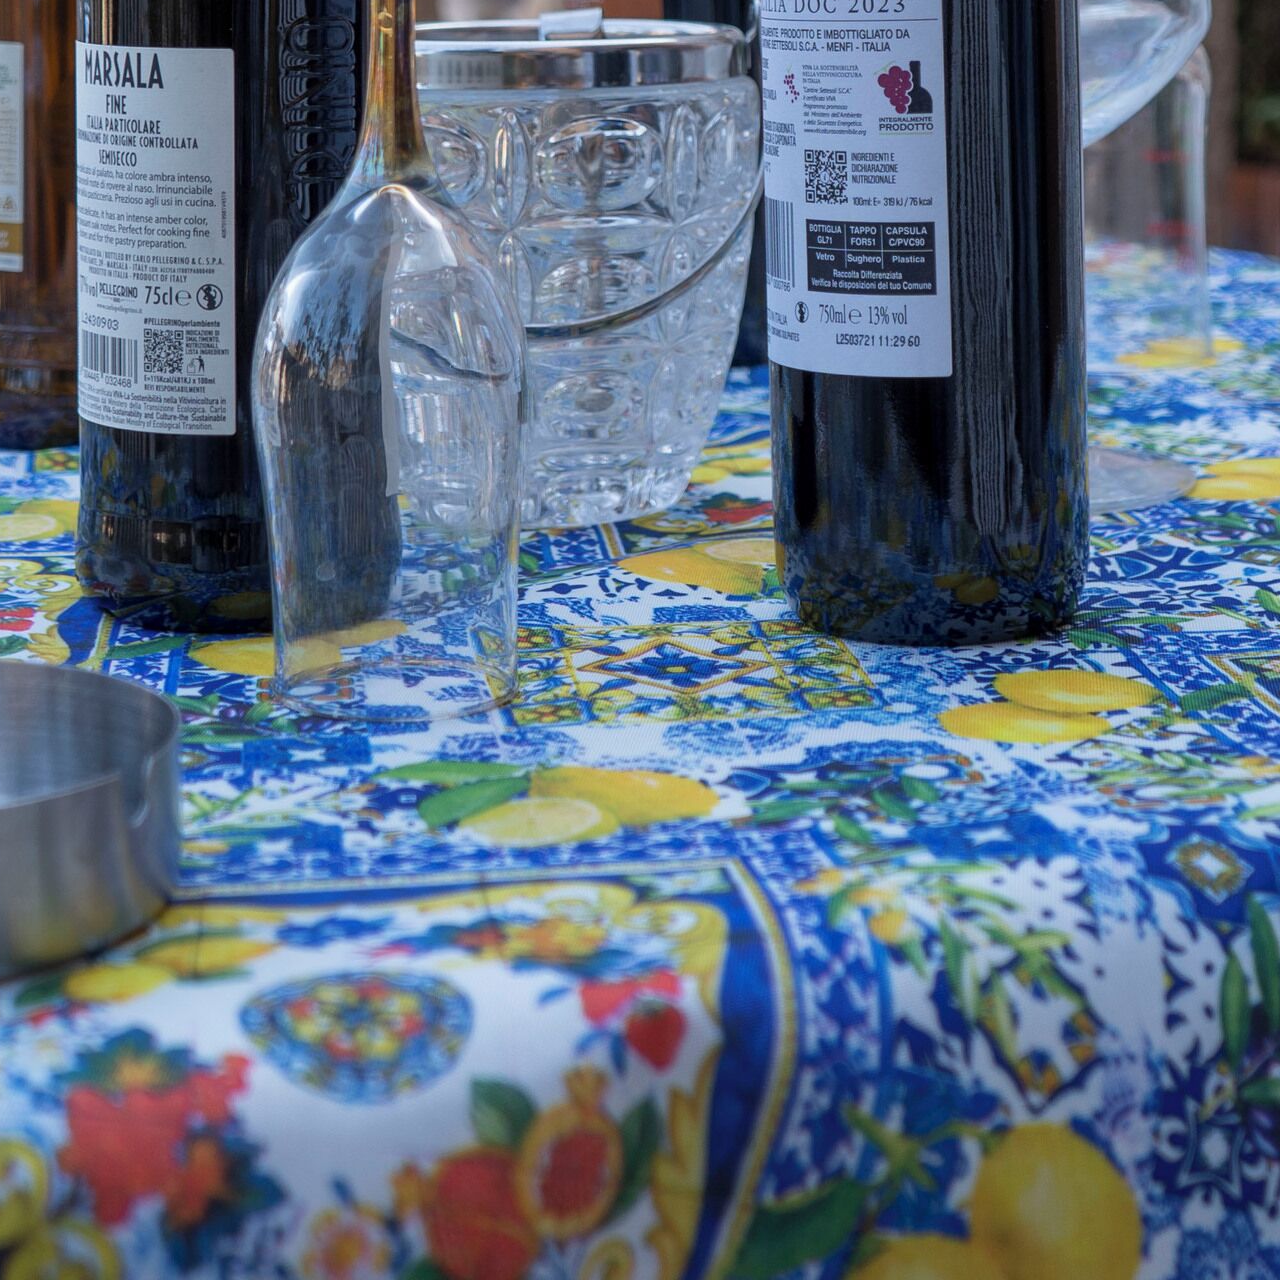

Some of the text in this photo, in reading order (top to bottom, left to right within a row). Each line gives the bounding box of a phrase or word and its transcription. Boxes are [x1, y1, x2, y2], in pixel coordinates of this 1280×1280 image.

[781, 28, 910, 40] PRODOTTO E IMBOTTIGLIATO DA
[772, 40, 891, 52] SETTESOLI S.C.A. MENFI ITALIA
[85, 49, 164, 89] MARSALA
[106, 94, 127, 115] FINE
[86, 115, 161, 135] ITALIA PARTICOLARE
[879, 123, 934, 131] PRODOTTO
[103, 134, 199, 150] DI ORIGINE CONTROLLATA
[99, 150, 137, 167] SEMISECCO
[851, 152, 895, 162] INGREDIENTI E
[851, 163, 898, 173] DICHIARAZIONE
[115, 170, 124, 179] ha
[125, 171, 147, 182] colore
[149, 172, 176, 182] ambra
[178, 173, 213, 184] intenso,
[851, 175, 896, 184] NUTRIZIONALE
[127, 183, 133, 192] al
[134, 184, 155, 193] naso.
[156, 185, 213, 195] Irrinunciabile
[115, 195, 143, 206] Prezioso
[144, 196, 159, 208] agli
[161, 197, 173, 207] usi
[174, 197, 183, 207] in
[184, 198, 217, 207] cucina.
[909, 197, 918, 206] 76
[919, 197, 933, 206] kcal
[106, 210, 116, 220] has
[117, 213, 125, 221] an
[126, 213, 153, 223] intense
[155, 214, 182, 225] amber
[184, 216, 208, 226] color,
[118, 223, 142, 234] Perfect
[144, 225, 155, 236] for
[157, 227, 191, 239] cooking
[192, 228, 210, 238] fine
[809, 223, 842, 234] BOTTIGLIA
[849, 226, 877, 235] TAPPO
[886, 226, 928, 235] CAPSULA
[105, 234, 114, 243] the
[115, 237, 136, 249] pastry
[138, 238, 186, 249] preparation.
[851, 237, 876, 246] FOR51
[888, 237, 925, 247] C/PVC90
[125, 253, 132, 262] BY
[132, 254, 151, 263] CARLO
[152, 255, 190, 265] PELLEGRINO
[815, 252, 835, 262] Vetro
[847, 254, 882, 265] Sughero
[892, 255, 926, 264] Plastica
[133, 263, 148, 271] ITALY
[133, 273, 159, 282] PRODUCT
[160, 274, 167, 282] OF
[170, 274, 187, 283] ITALY
[833, 268, 902, 280] Raccolta Differenziata
[811, 277, 932, 291] Verifica le disposizioni del tuo Comune
[99, 282, 138, 298] PELLEGRINO
[145, 286, 172, 306] 75cl
[819, 303, 908, 325] 750ml 13% vol
[836, 333, 875, 347] L2503721
[879, 335, 906, 347] 11:29
[104, 375, 132, 388] 032468
[154, 385, 205, 394] RESPONSABILMENTE
[179, 396, 219, 405] Vitivinicoltura
[220, 396, 226, 404] in
[209, 405, 226, 413] Carlo
[144, 411, 154, 420] and
[191, 413, 226, 423] Sustainable
[153, 420, 180, 430] Ecological
